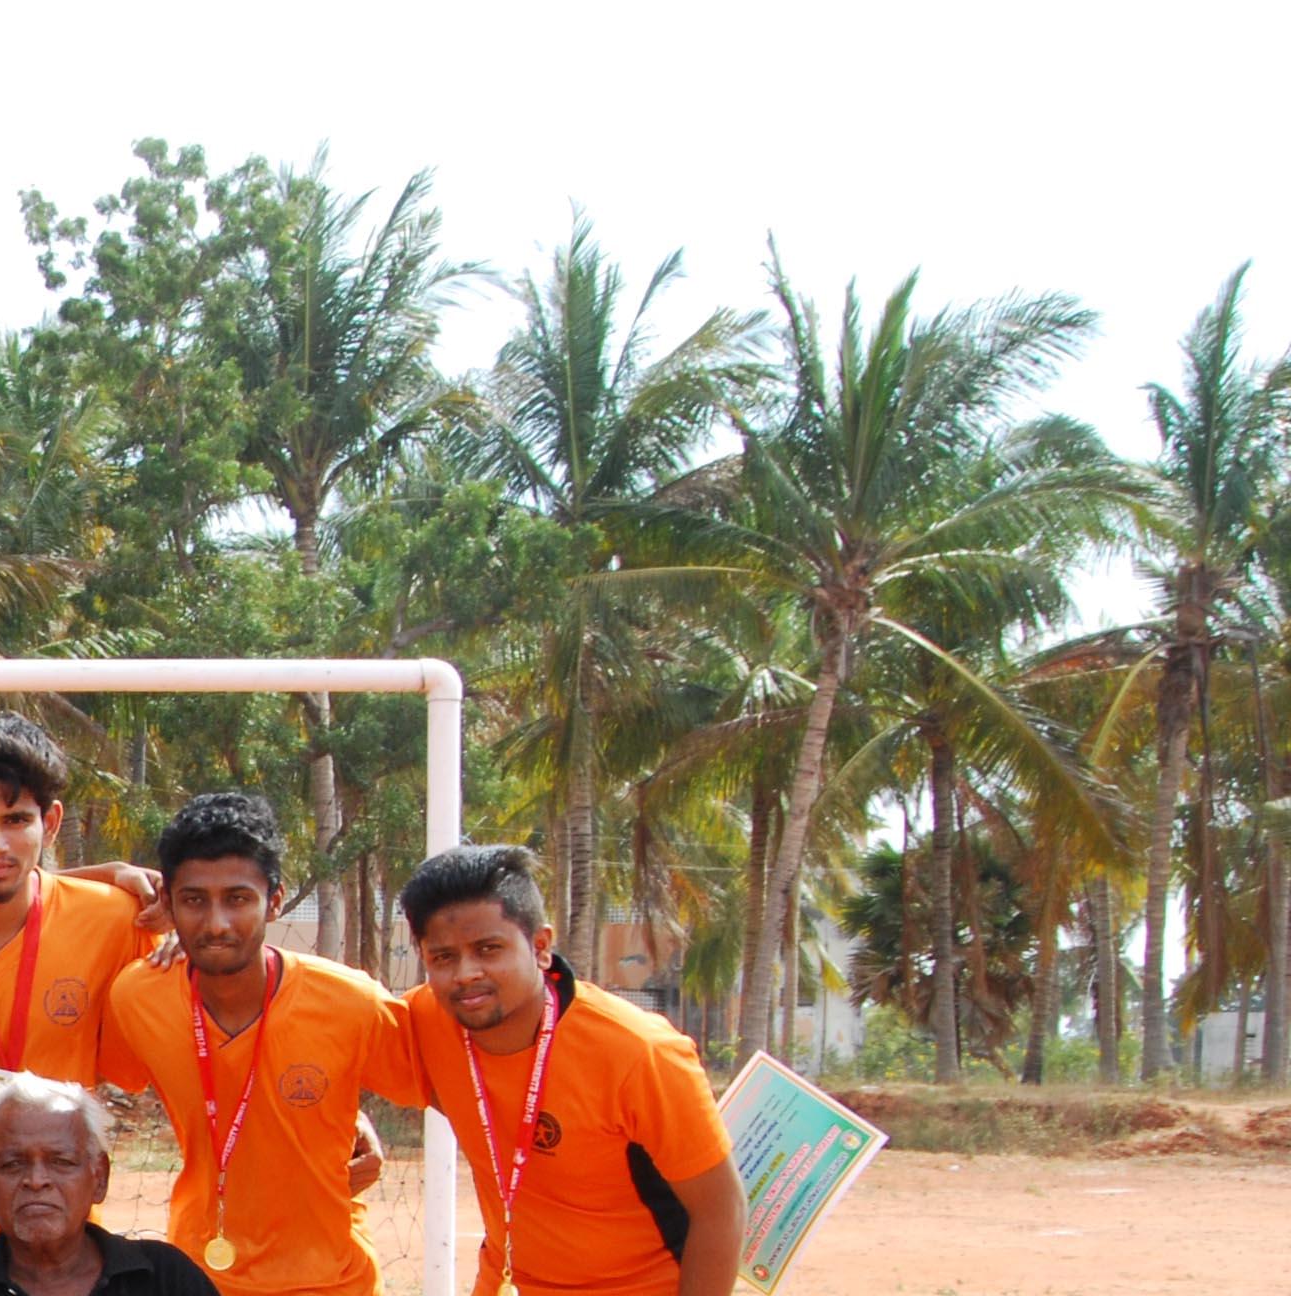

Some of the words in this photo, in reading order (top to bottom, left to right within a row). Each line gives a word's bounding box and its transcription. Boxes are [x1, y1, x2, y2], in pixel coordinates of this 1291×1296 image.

[540, 1004, 557, 1033] ZONAL
[194, 1026, 207, 1057] 2017-18
[528, 1031, 552, 1093] TOURNAMENTS
[521, 1091, 538, 1124] 2017-18
